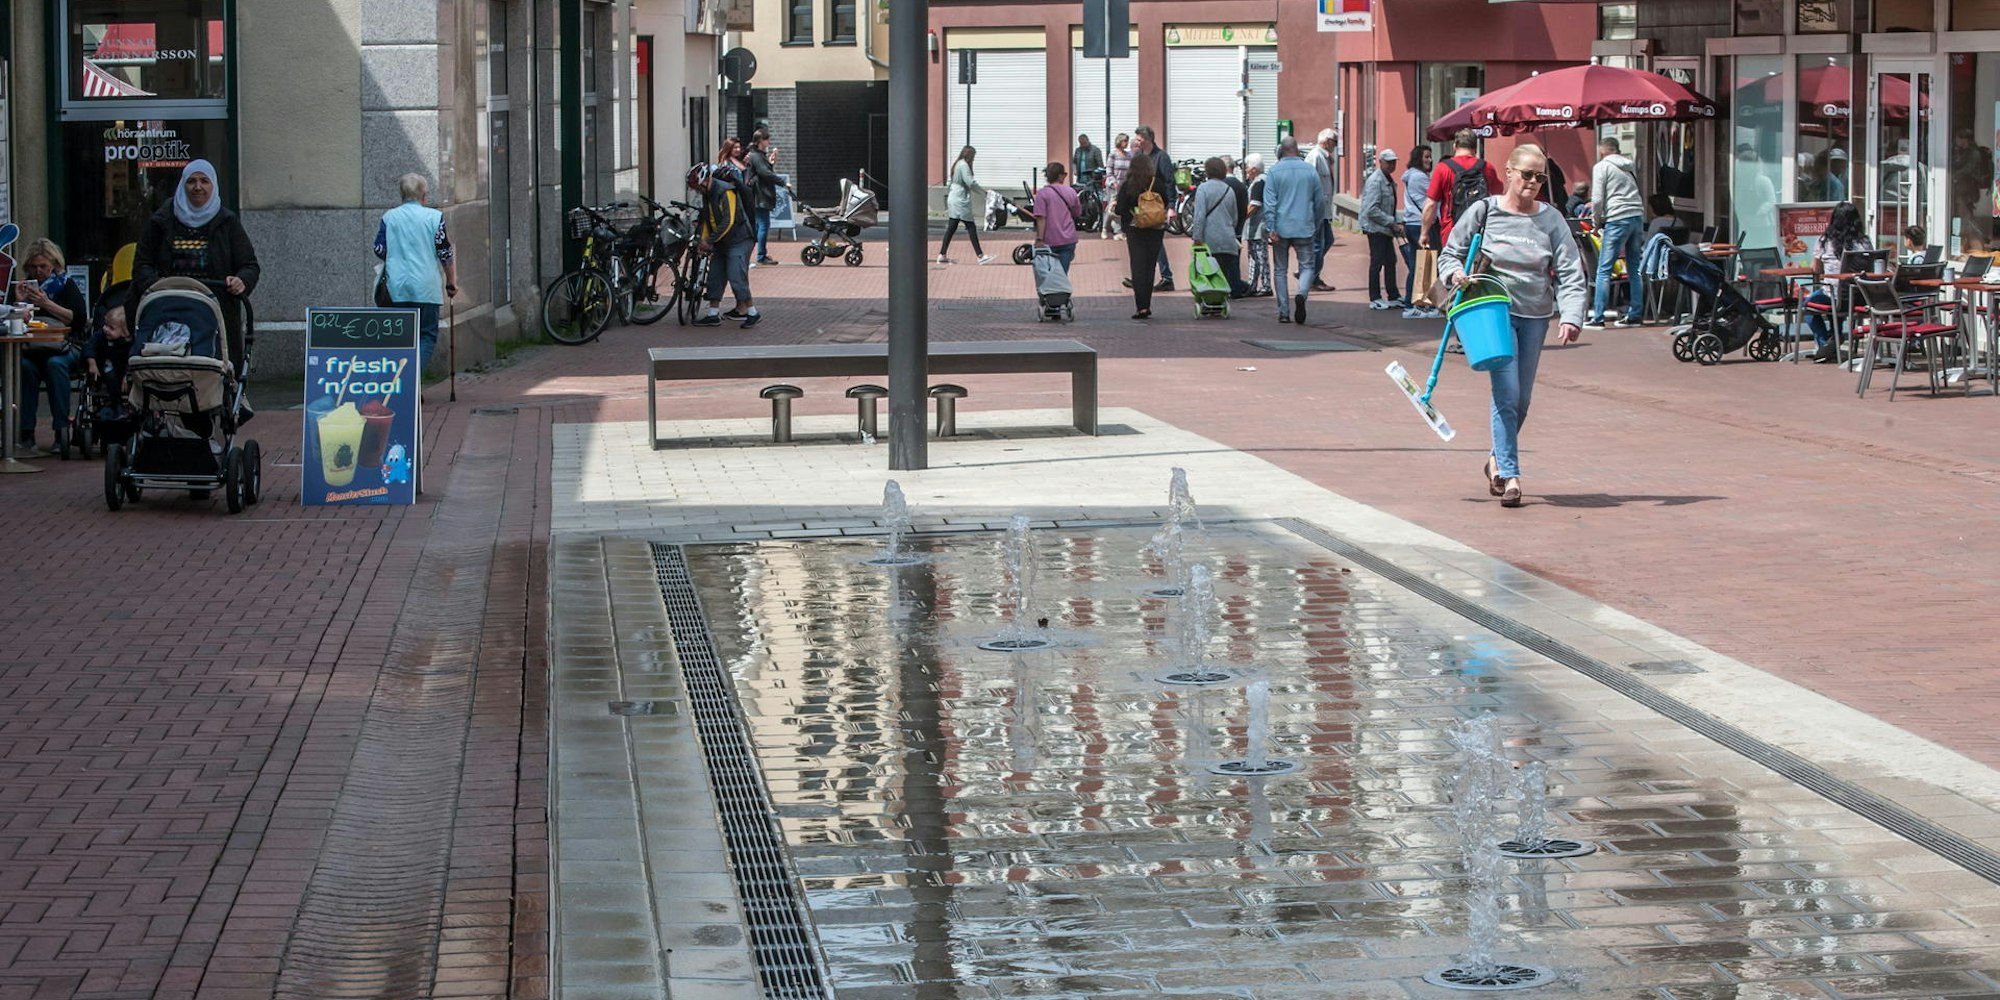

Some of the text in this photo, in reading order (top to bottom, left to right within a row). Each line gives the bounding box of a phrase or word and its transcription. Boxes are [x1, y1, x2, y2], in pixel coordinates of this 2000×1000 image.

[101, 49, 197, 60] GUNNARSSON
[1535, 106, 1562, 117] Kamps
[1621, 105, 1649, 115] Kamps
[117, 128, 176, 138] hörzentrum
[326, 356, 398, 374] fresh
